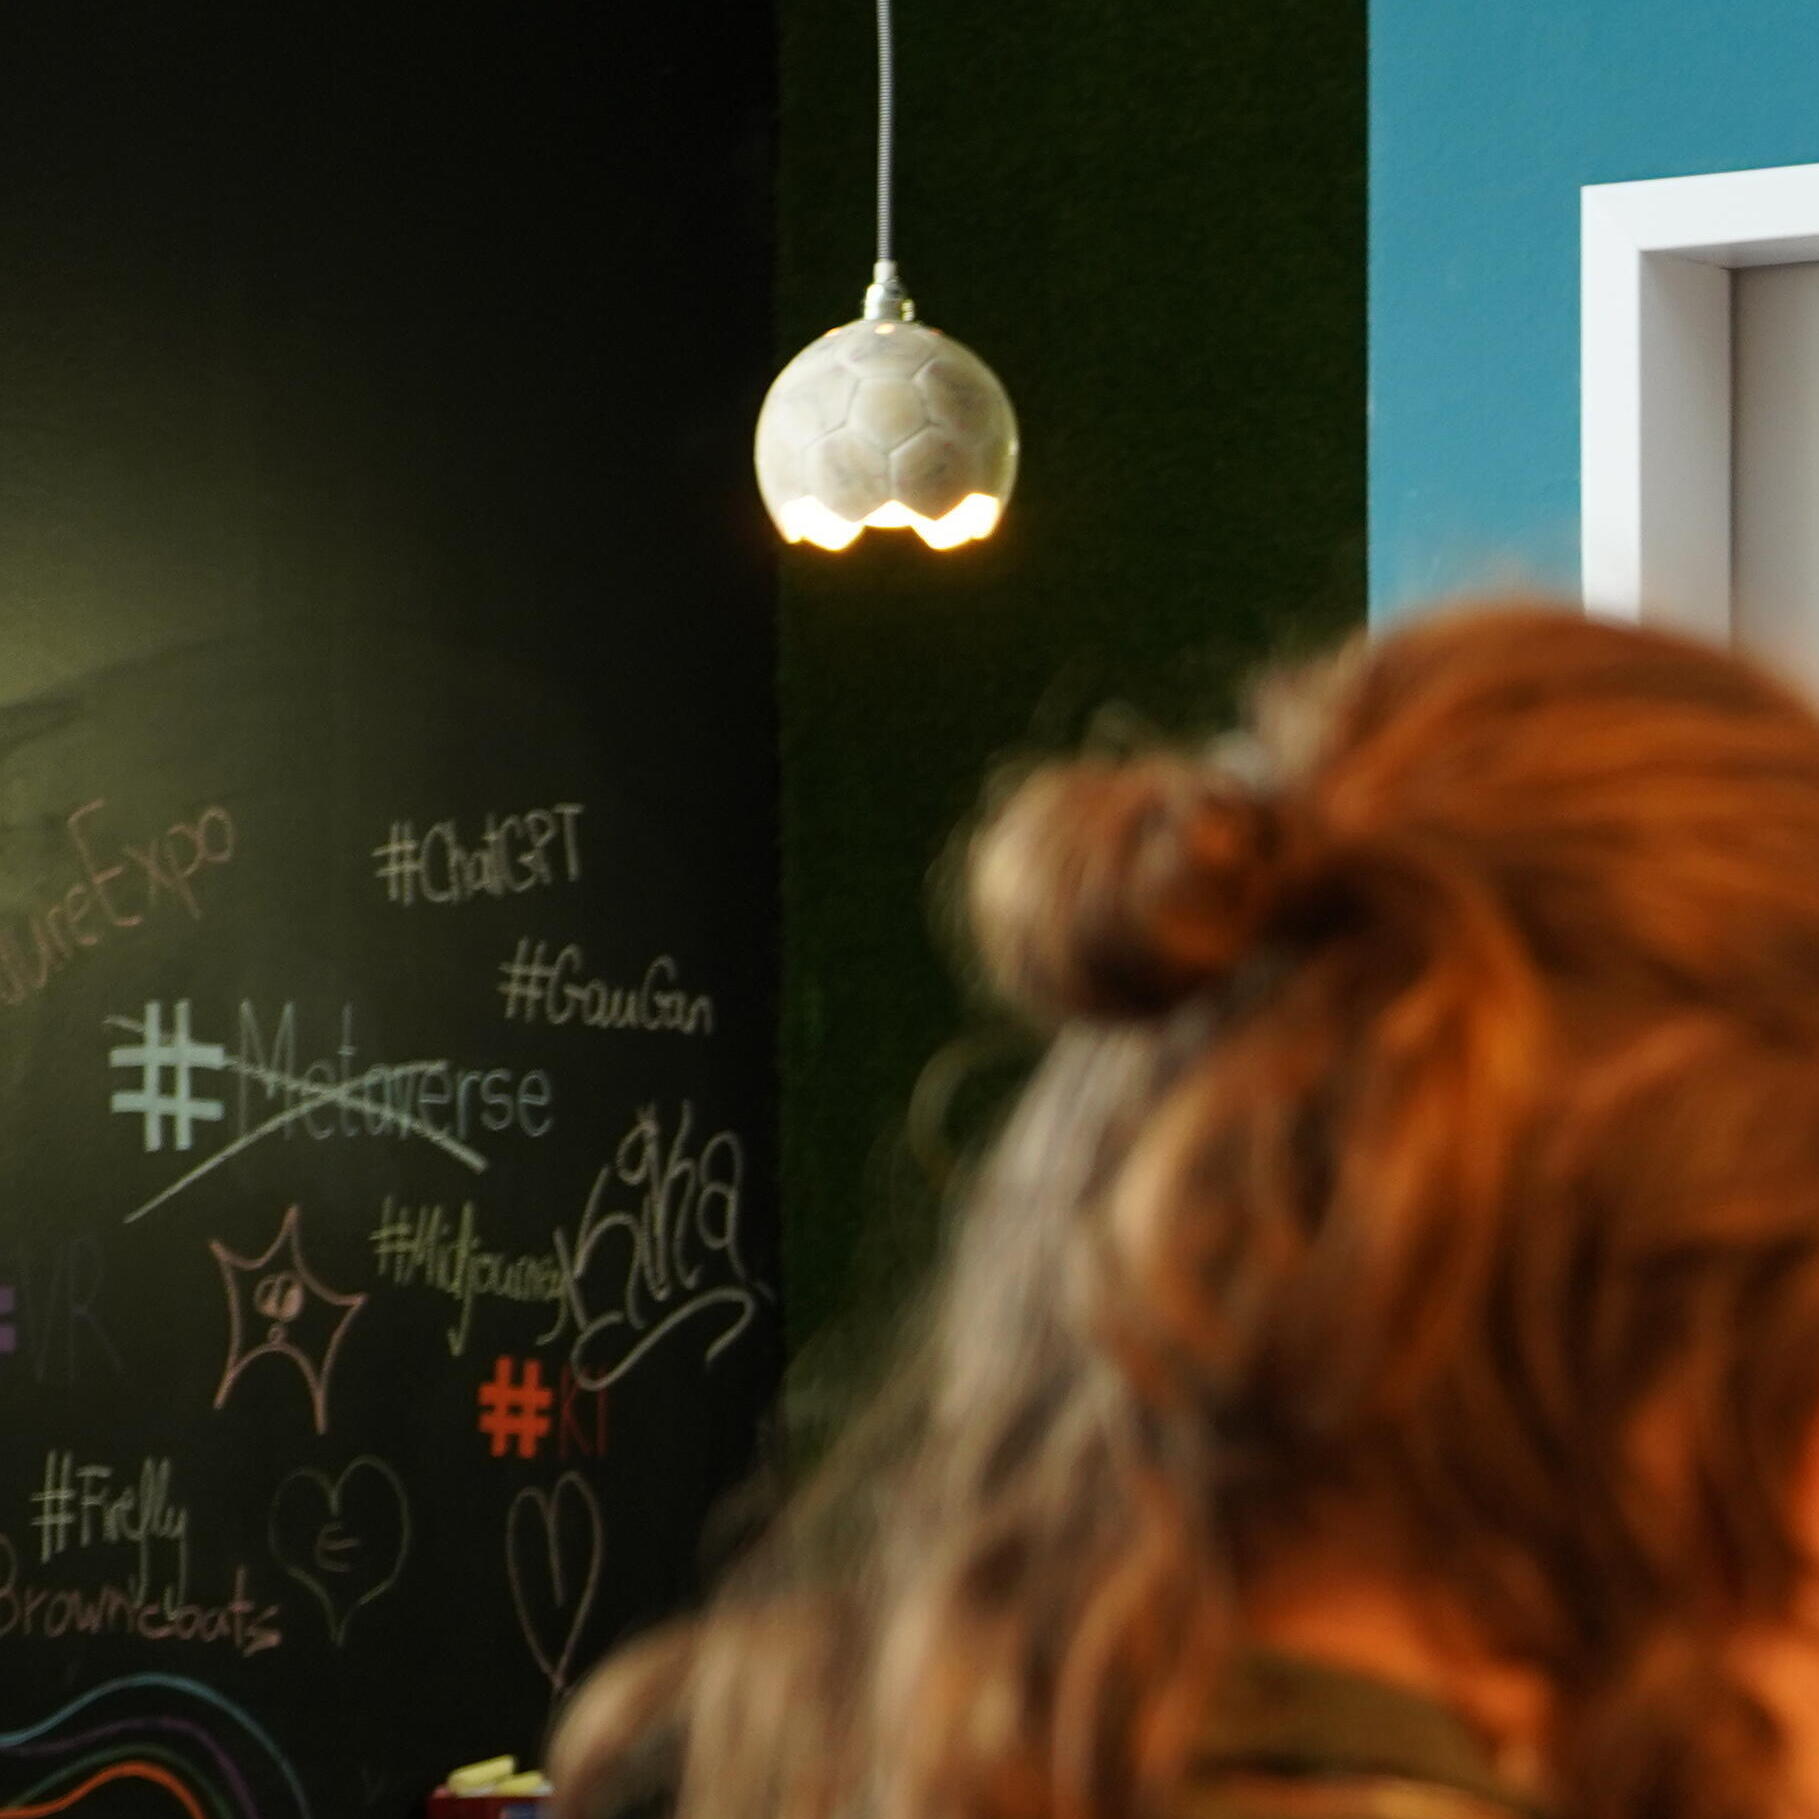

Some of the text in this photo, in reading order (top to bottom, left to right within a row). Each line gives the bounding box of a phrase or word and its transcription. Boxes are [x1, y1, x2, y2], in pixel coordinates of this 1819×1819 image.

[371, 803, 585, 904] #ChatGPT
[109, 997, 553, 1153] #Metaverse
[478, 1354, 608, 1459] #KI
